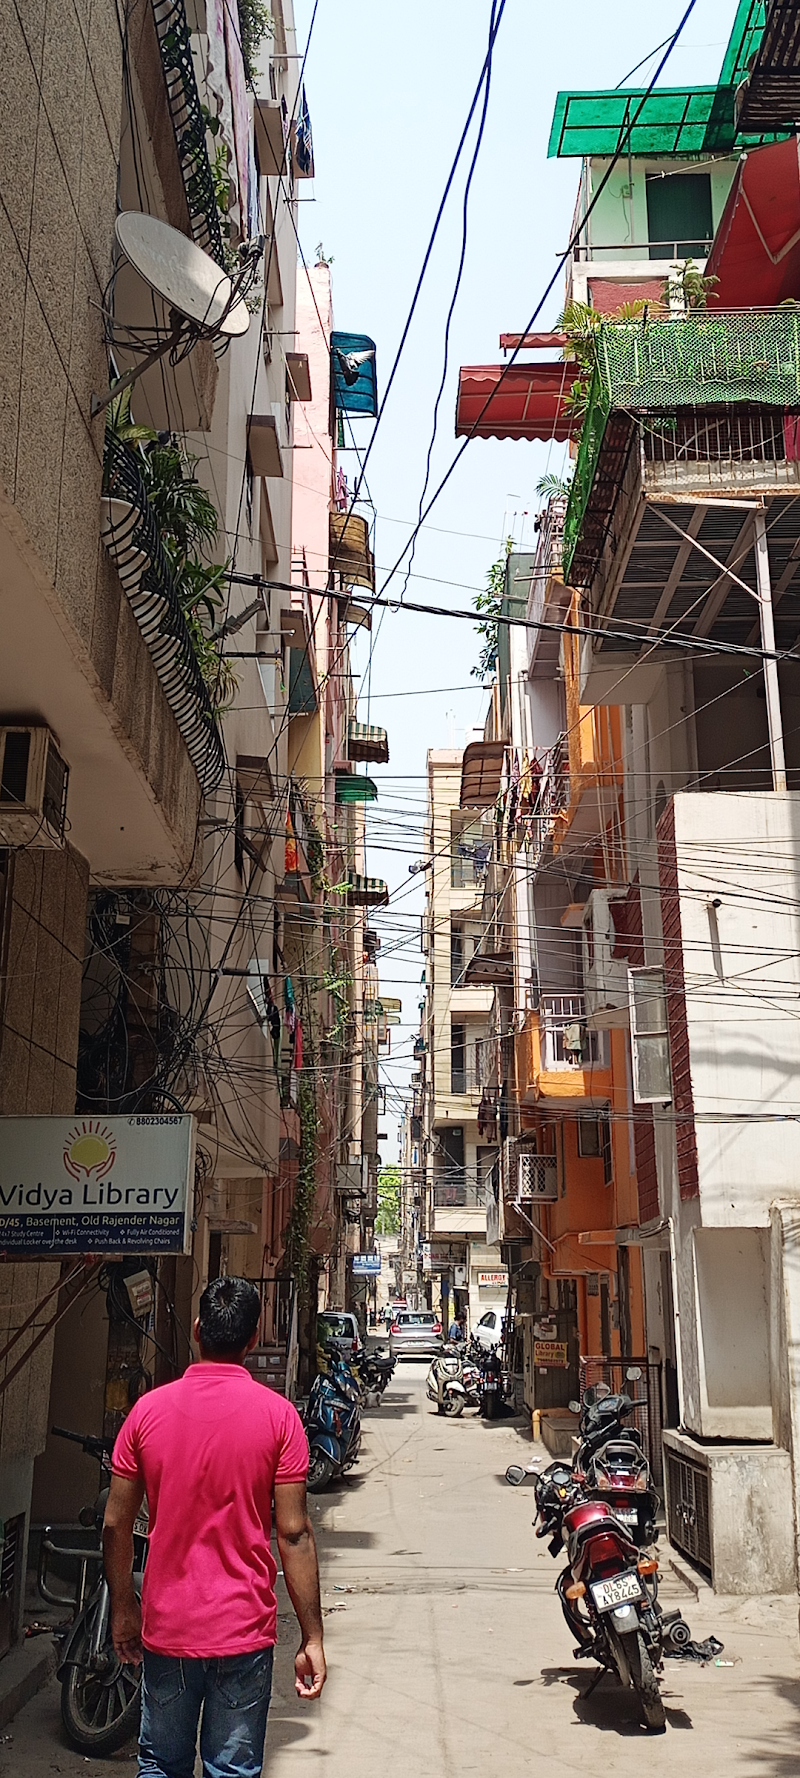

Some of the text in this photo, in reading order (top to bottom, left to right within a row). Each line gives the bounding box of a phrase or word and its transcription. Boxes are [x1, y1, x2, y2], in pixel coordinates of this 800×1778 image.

[136, 1116, 183, 1125] 8802304567
[0, 1182, 179, 1210] Vidya Library
[26, 1216, 79, 1227] Basement,
[81, 1215, 100, 1225] Old
[102, 1215, 147, 1227] Rajender
[149, 1215, 180, 1227] Nagar
[11, 1230, 26, 1238] Study
[76, 1229, 110, 1237] Connectivity
[126, 1228, 139, 1237] Fully
[127, 1238, 154, 1246] Revolving
[535, 1342, 565, 1351] GLOBAL
[535, 1350, 554, 1358] Library
[602, 1584, 640, 1606] AY8445
